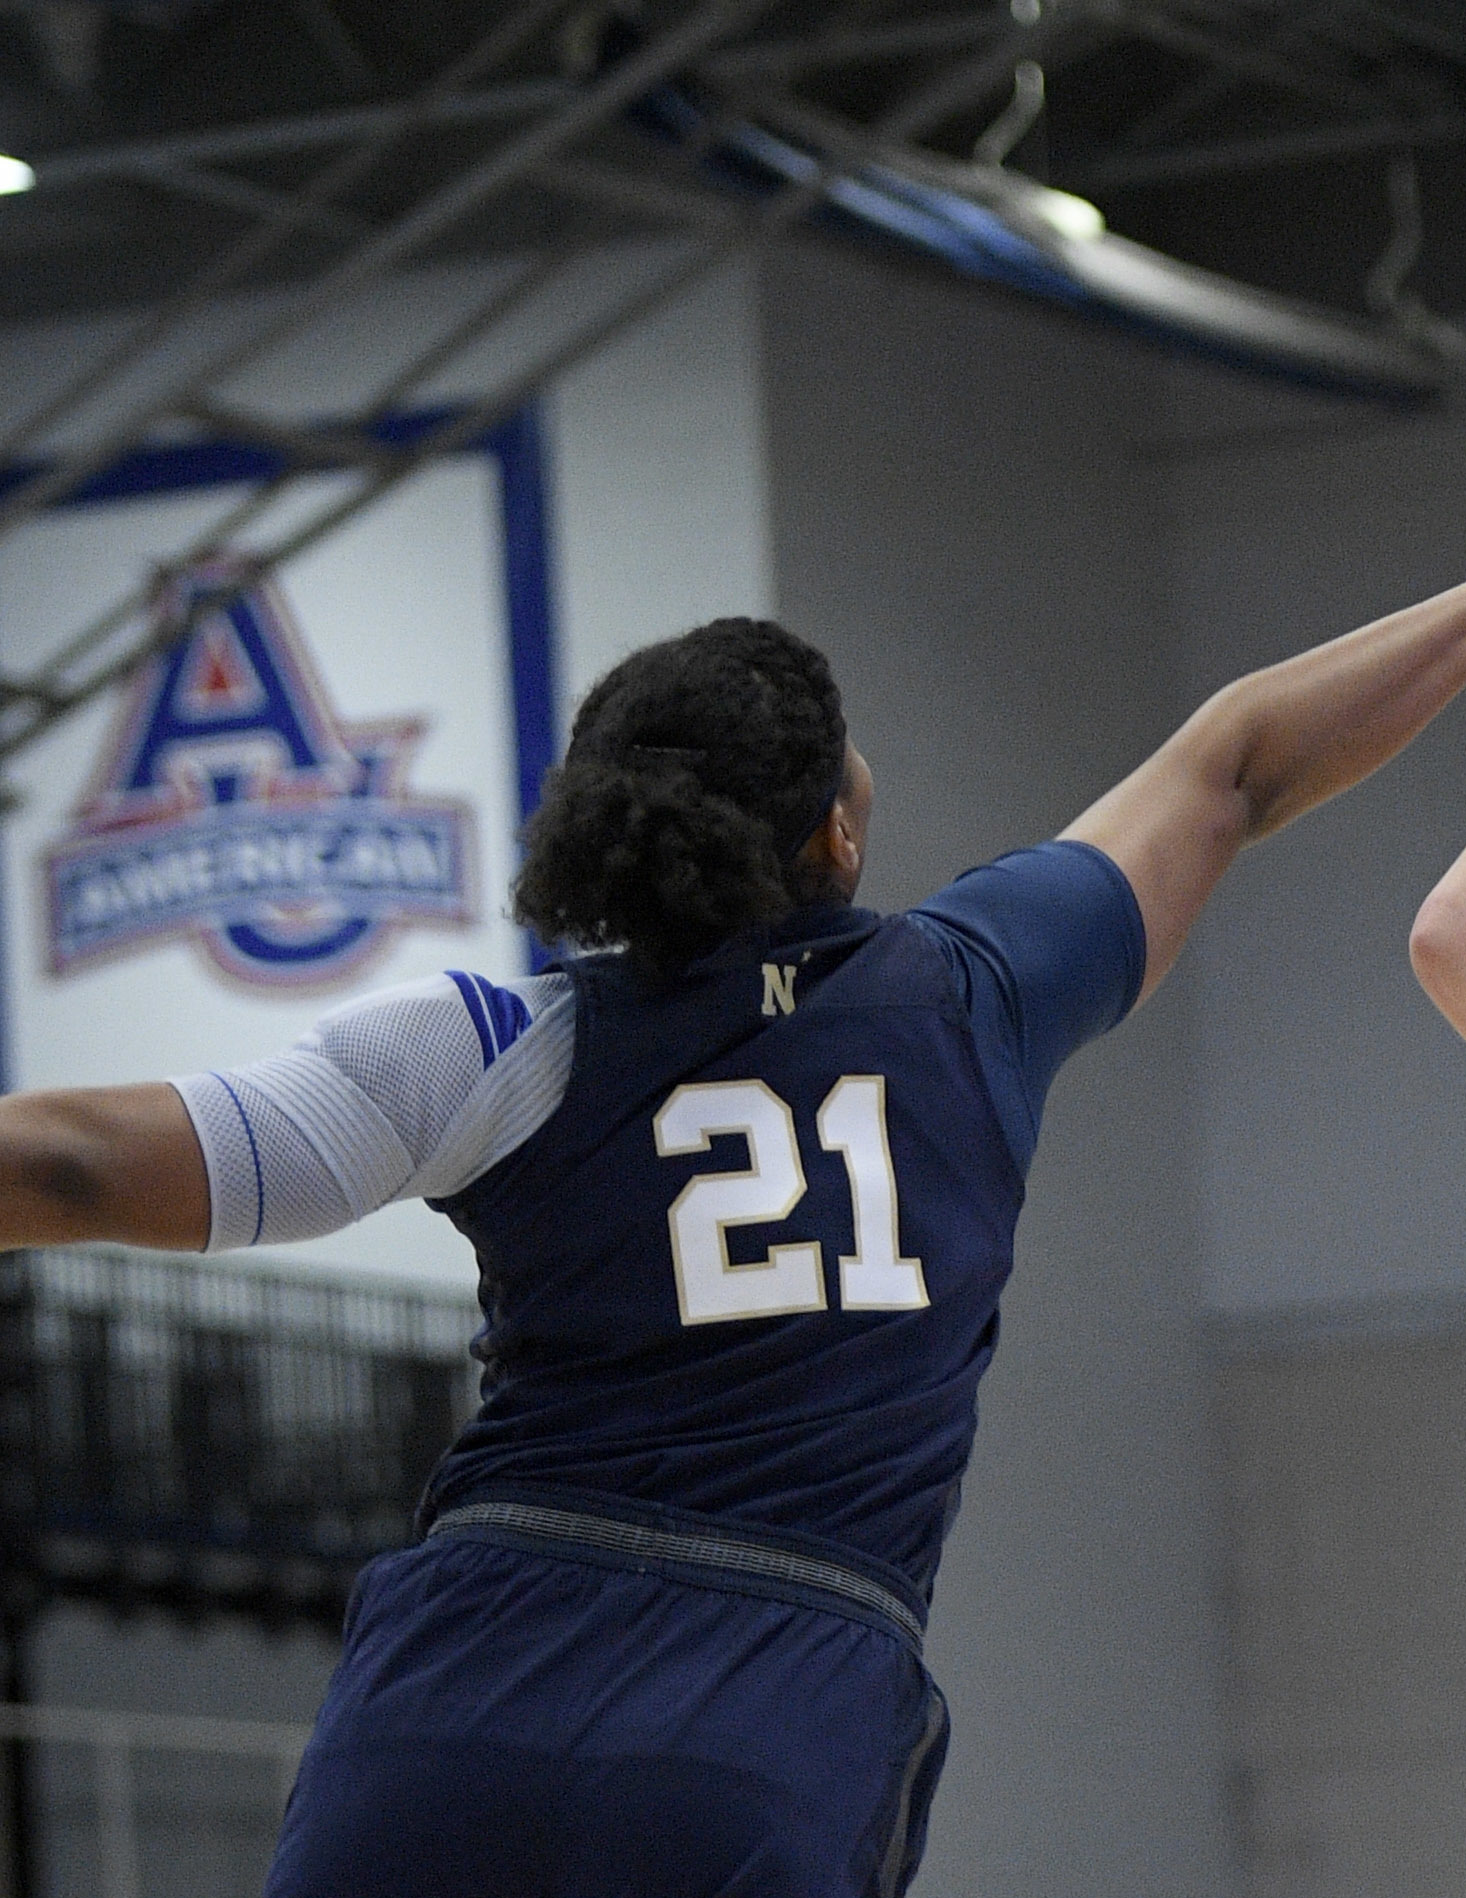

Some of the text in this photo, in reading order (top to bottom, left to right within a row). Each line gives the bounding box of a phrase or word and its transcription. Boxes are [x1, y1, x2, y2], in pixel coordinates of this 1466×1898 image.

[78, 830, 442, 918] AMERICAN
[761, 962, 798, 1016] N
[653, 1074, 932, 1327] 21
